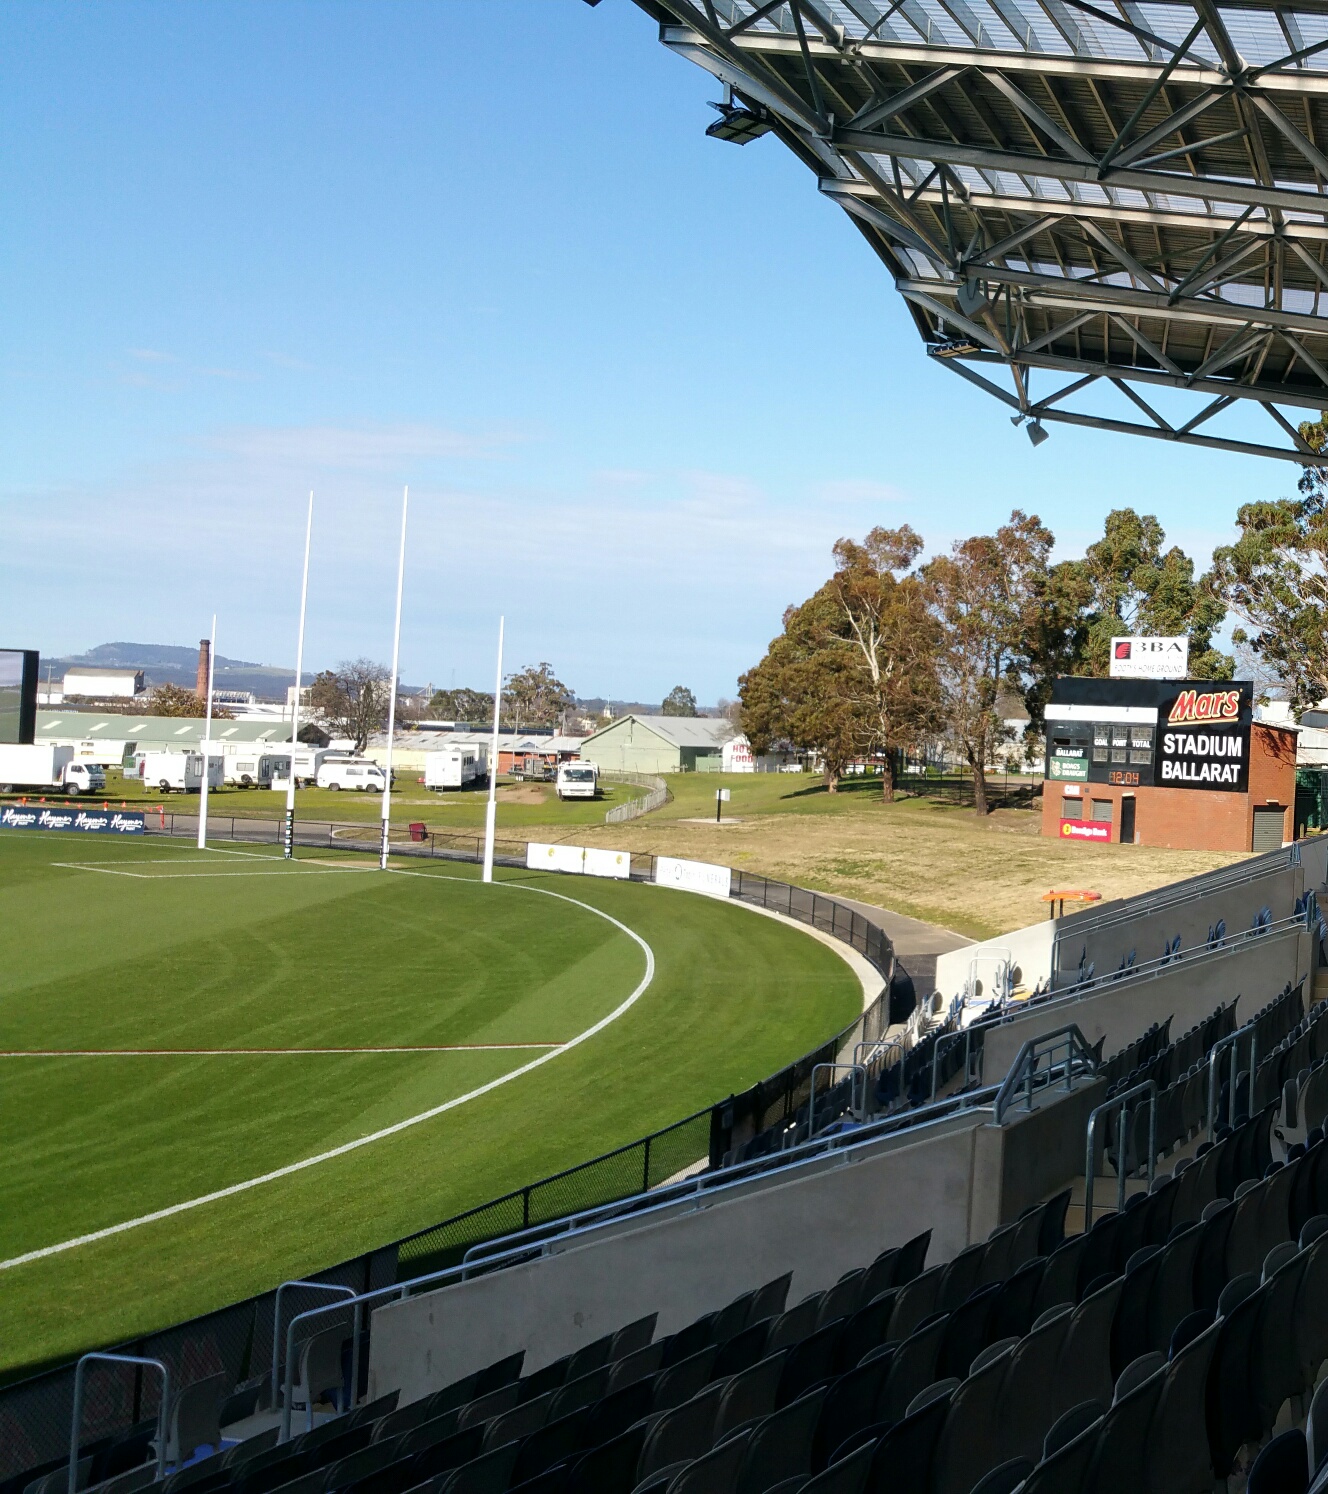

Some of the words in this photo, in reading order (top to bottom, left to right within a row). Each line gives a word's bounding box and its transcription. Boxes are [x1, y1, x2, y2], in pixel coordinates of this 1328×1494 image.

[1135, 642, 1183, 653] 3BA
[1156, 664, 1183, 673] GROUND
[1168, 689, 1240, 723] Mars
[1132, 740, 1151, 748] TOTAL
[1163, 733, 1242, 757] STADIUM
[731, 754, 753, 763] FOOD
[1056, 749, 1083, 757] BALLARAT
[1161, 760, 1241, 783] BALLARAT
[1111, 771, 1140, 785] 12:04
